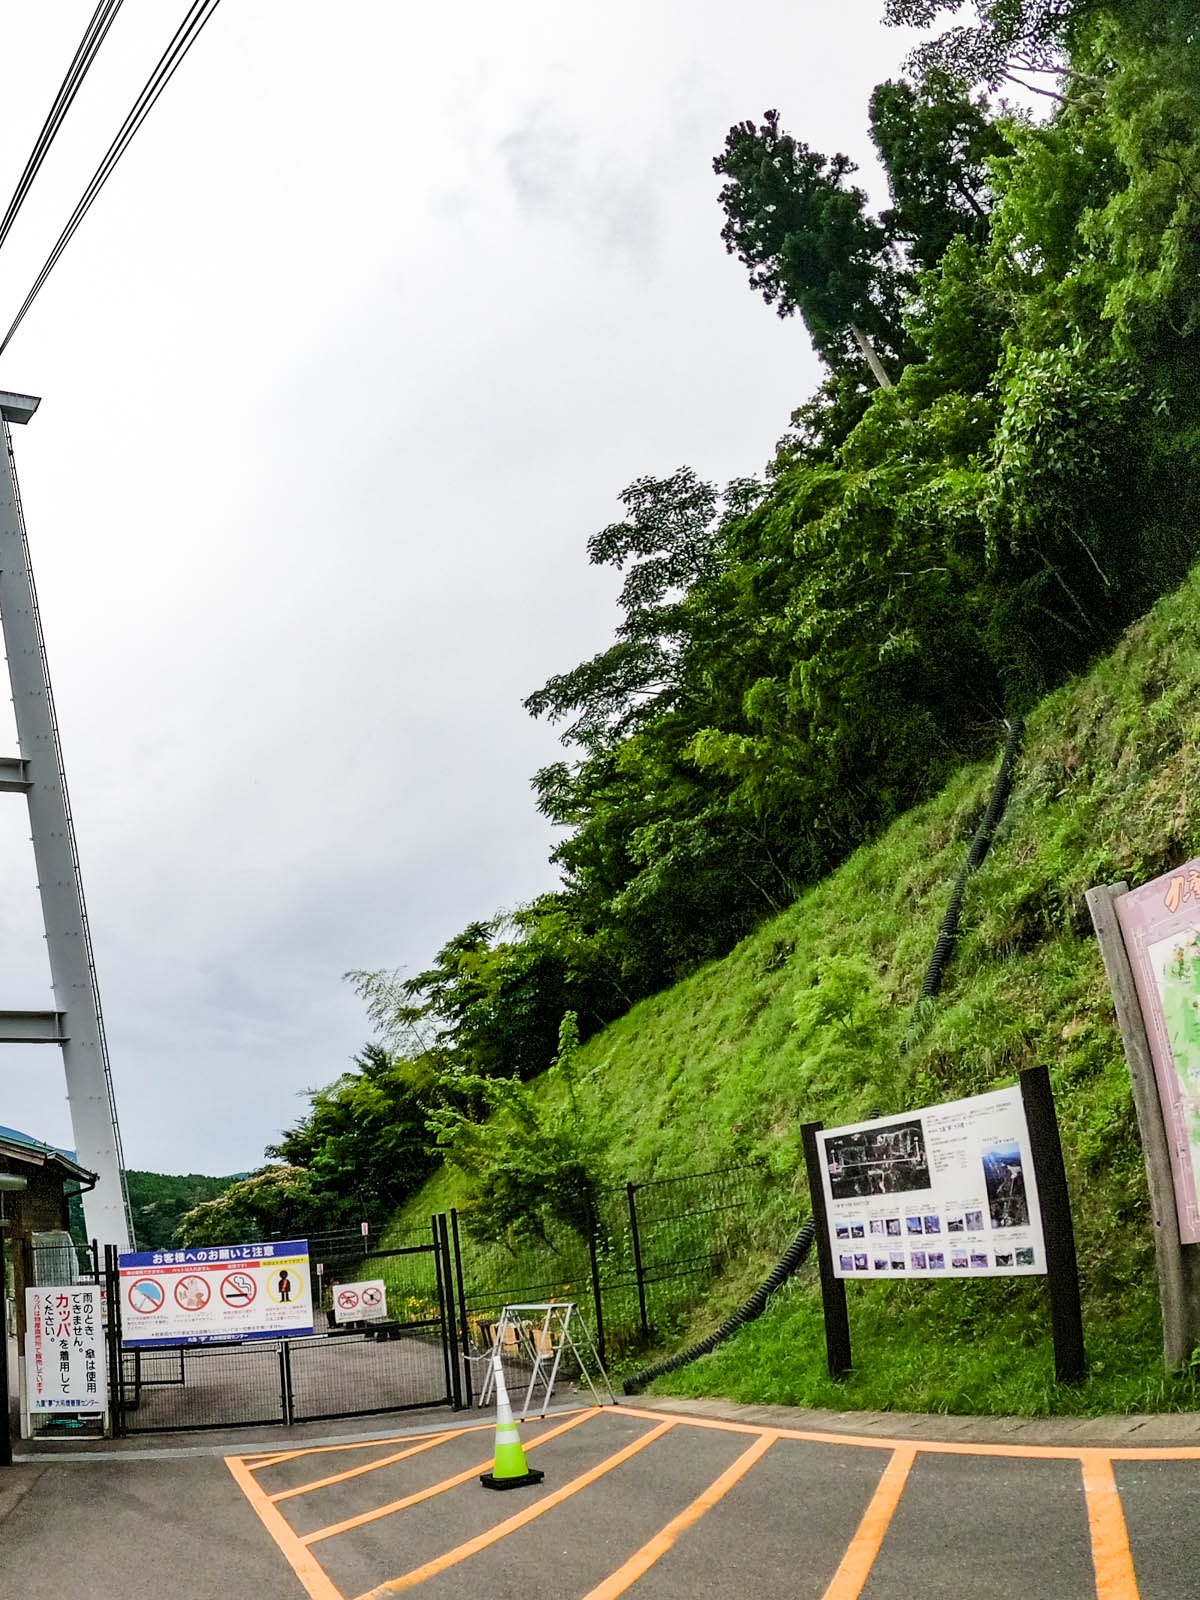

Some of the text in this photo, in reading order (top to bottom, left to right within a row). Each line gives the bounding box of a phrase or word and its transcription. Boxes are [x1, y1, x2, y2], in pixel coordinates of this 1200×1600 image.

[152, 1245, 275, 1264] お客様へのお願いと注意
[44, 1294, 55, 1343] ください。
[72, 1293, 84, 1353] できません。
